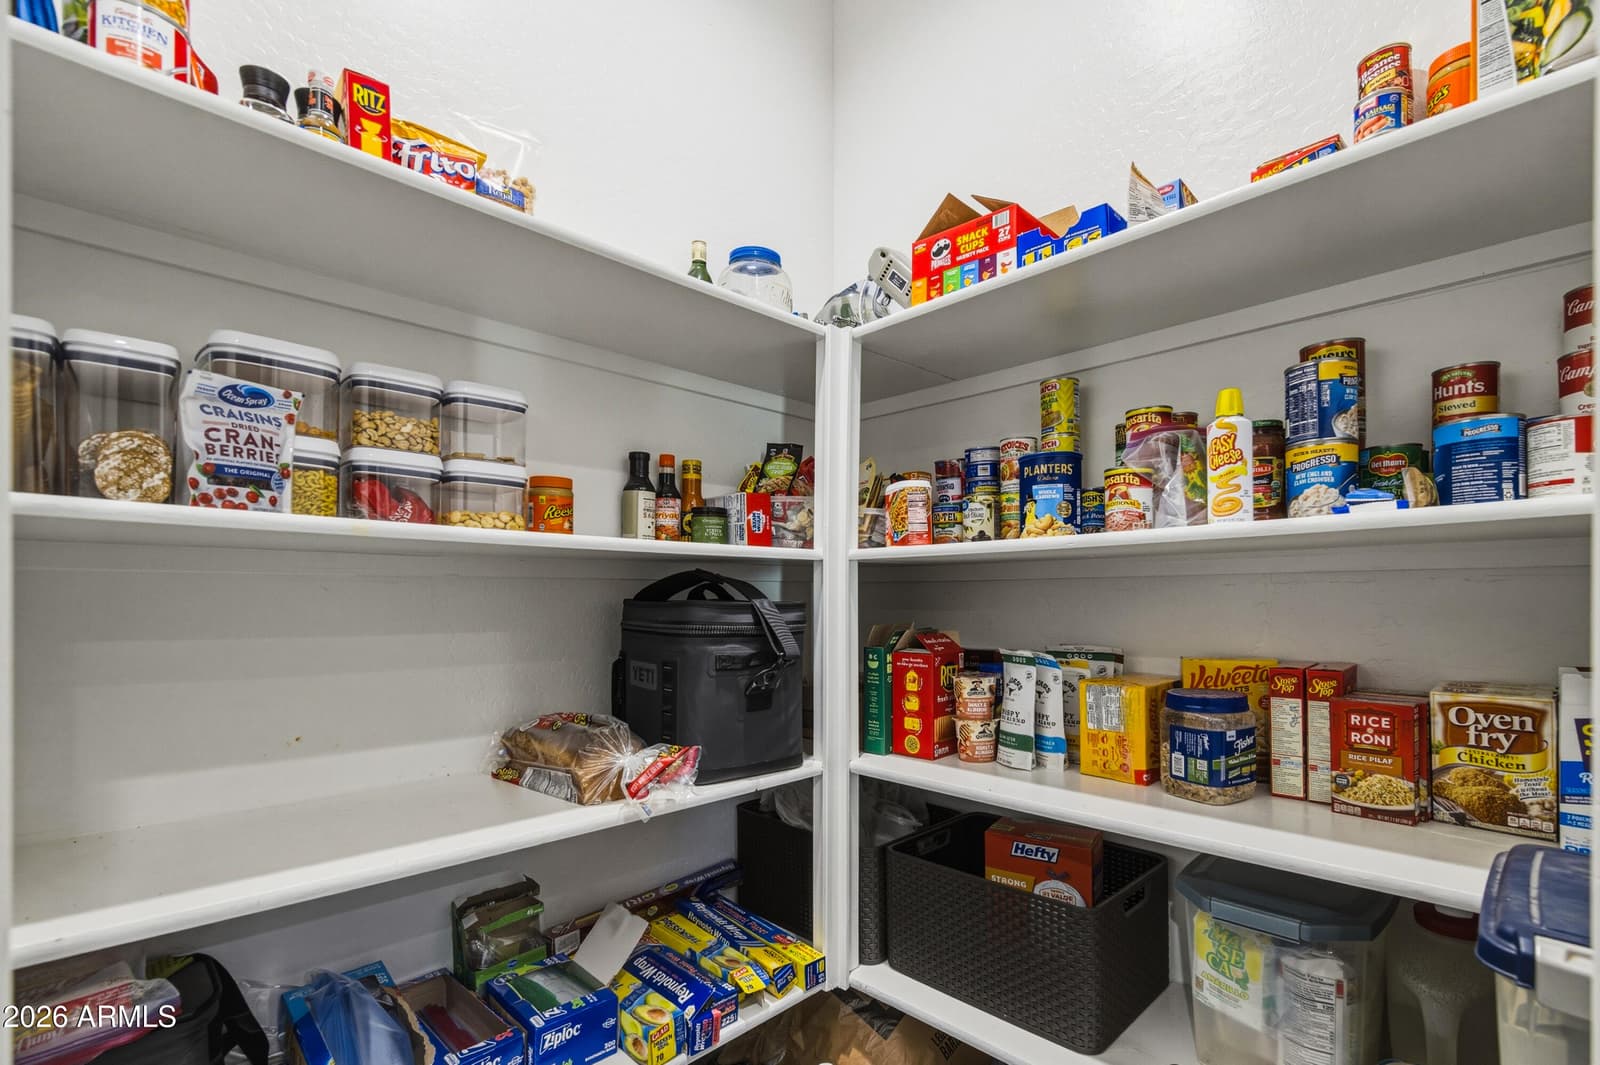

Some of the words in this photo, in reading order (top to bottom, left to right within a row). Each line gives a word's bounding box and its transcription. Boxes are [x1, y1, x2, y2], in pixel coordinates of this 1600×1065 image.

[352, 82, 386, 114] RITZ
[957, 226, 988, 246] SNACK
[998, 226, 1010, 236] 27
[960, 238, 985, 254] CUPS
[222, 389, 245, 404] Ocean
[245, 397, 268, 407] Spray
[1438, 400, 1477, 413] Stewed
[200, 404, 282, 428] CRAISINS
[231, 422, 260, 433] DRIED
[204, 427, 281, 451] CRAN-
[1211, 433, 1236, 454] EASY
[1024, 463, 1073, 478] PLANTERS
[1292, 455, 1337, 472] PROGRESSO
[1383, 459, 1406, 467] Monte
[224, 467, 238, 475] THE
[239, 469, 271, 479] ORIGINAL
[633, 666, 655, 685] YETI
[1190, 664, 1269, 689] Velveeta
[1272, 675, 1298, 690] Stove
[1280, 684, 1295, 694] Top
[1308, 678, 1338, 694] Stove
[1319, 687, 1334, 697] Top
[1350, 714, 1391, 729] RICE
[1448, 706, 1535, 732] Oven
[1351, 733, 1391, 747] RONI
[1466, 724, 1518, 753] fry
[1348, 754, 1367, 762] RICE
[1369, 757, 1393, 765] PILAF
[1457, 751, 1527, 771] Chicken
[1014, 843, 1056, 862] Hefty
[991, 874, 1027, 889] STRONG
[633, 956, 659, 979] Wrap
[653, 970, 694, 1004] Reynolds
[543, 1023, 582, 1050] Ziploc
[652, 1024, 670, 1041] GLAD
